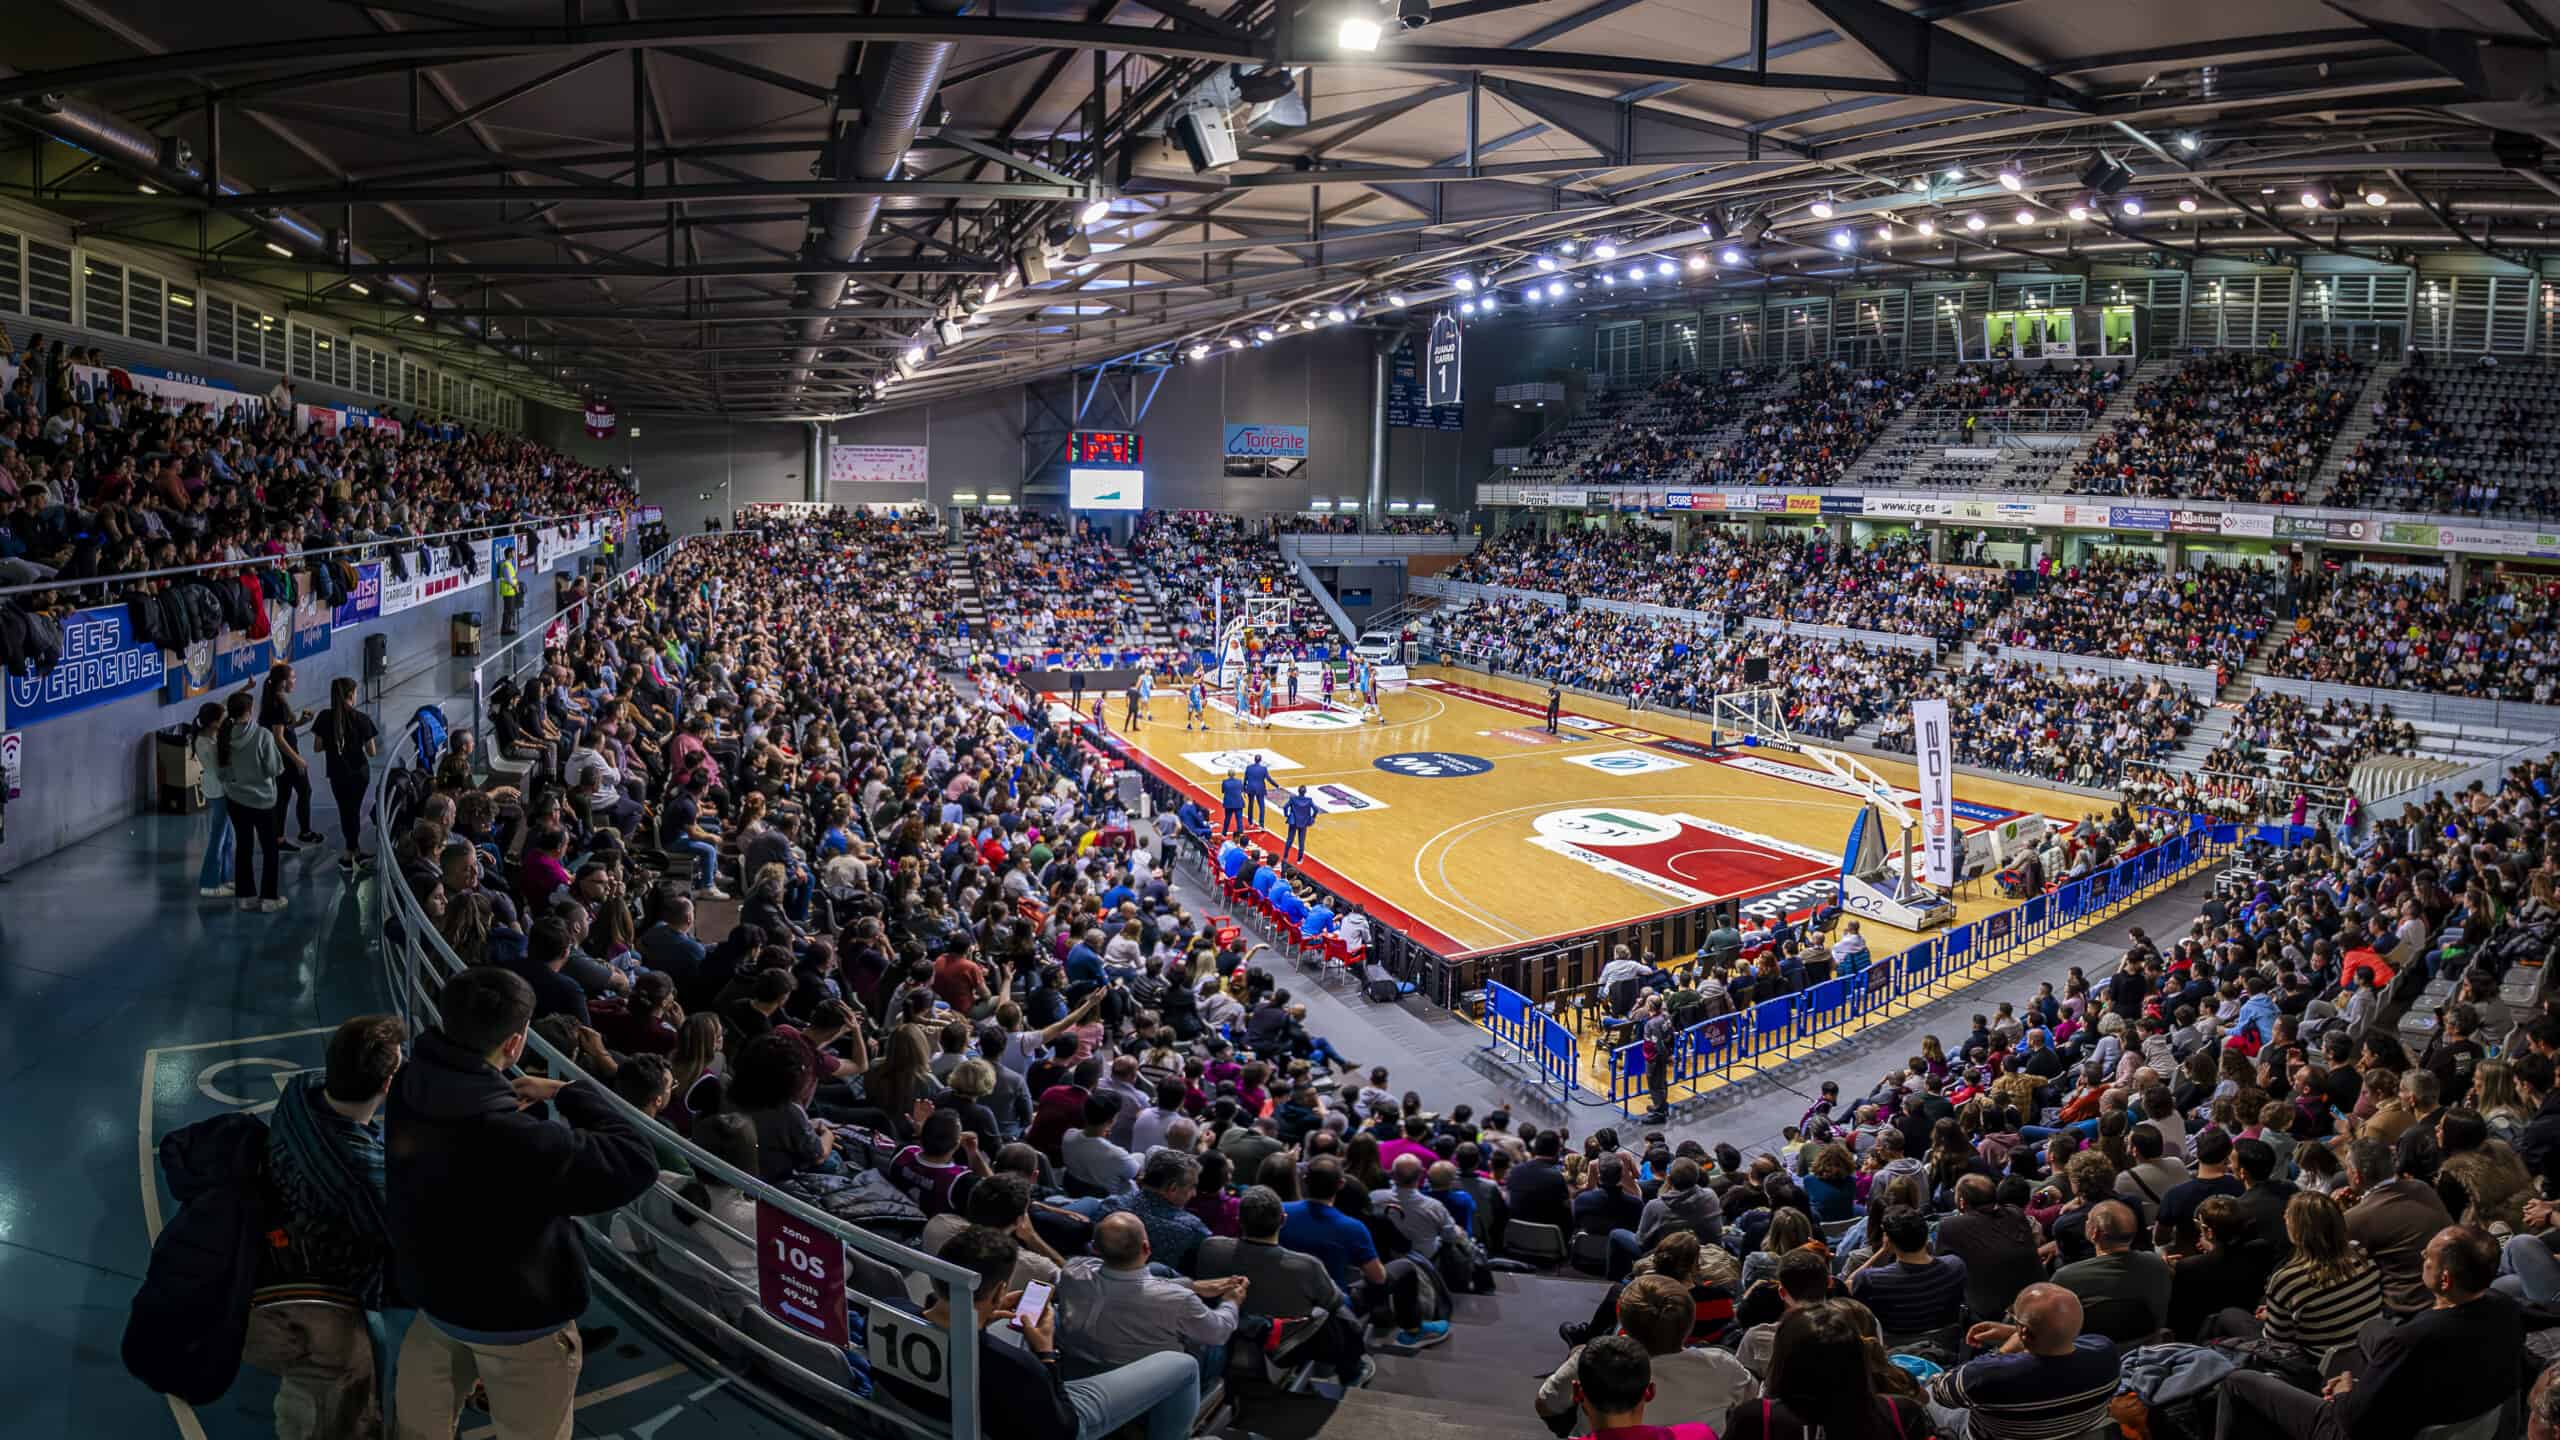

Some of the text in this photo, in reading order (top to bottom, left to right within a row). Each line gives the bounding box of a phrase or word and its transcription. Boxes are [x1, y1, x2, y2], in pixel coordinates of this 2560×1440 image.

[1438, 364, 1447, 393] 1
[1245, 431, 1305, 449] Torrente
[1668, 495, 1692, 507] SEGRE
[1789, 498, 1818, 510] DHL
[1881, 502, 1936, 515] www.icg.es
[45, 648, 141, 704] GARCIA
[141, 652, 162, 679] SL
[782, 1225, 811, 1245] zona
[774, 1238, 826, 1280] 10S
[871, 1323, 943, 1384] 10
